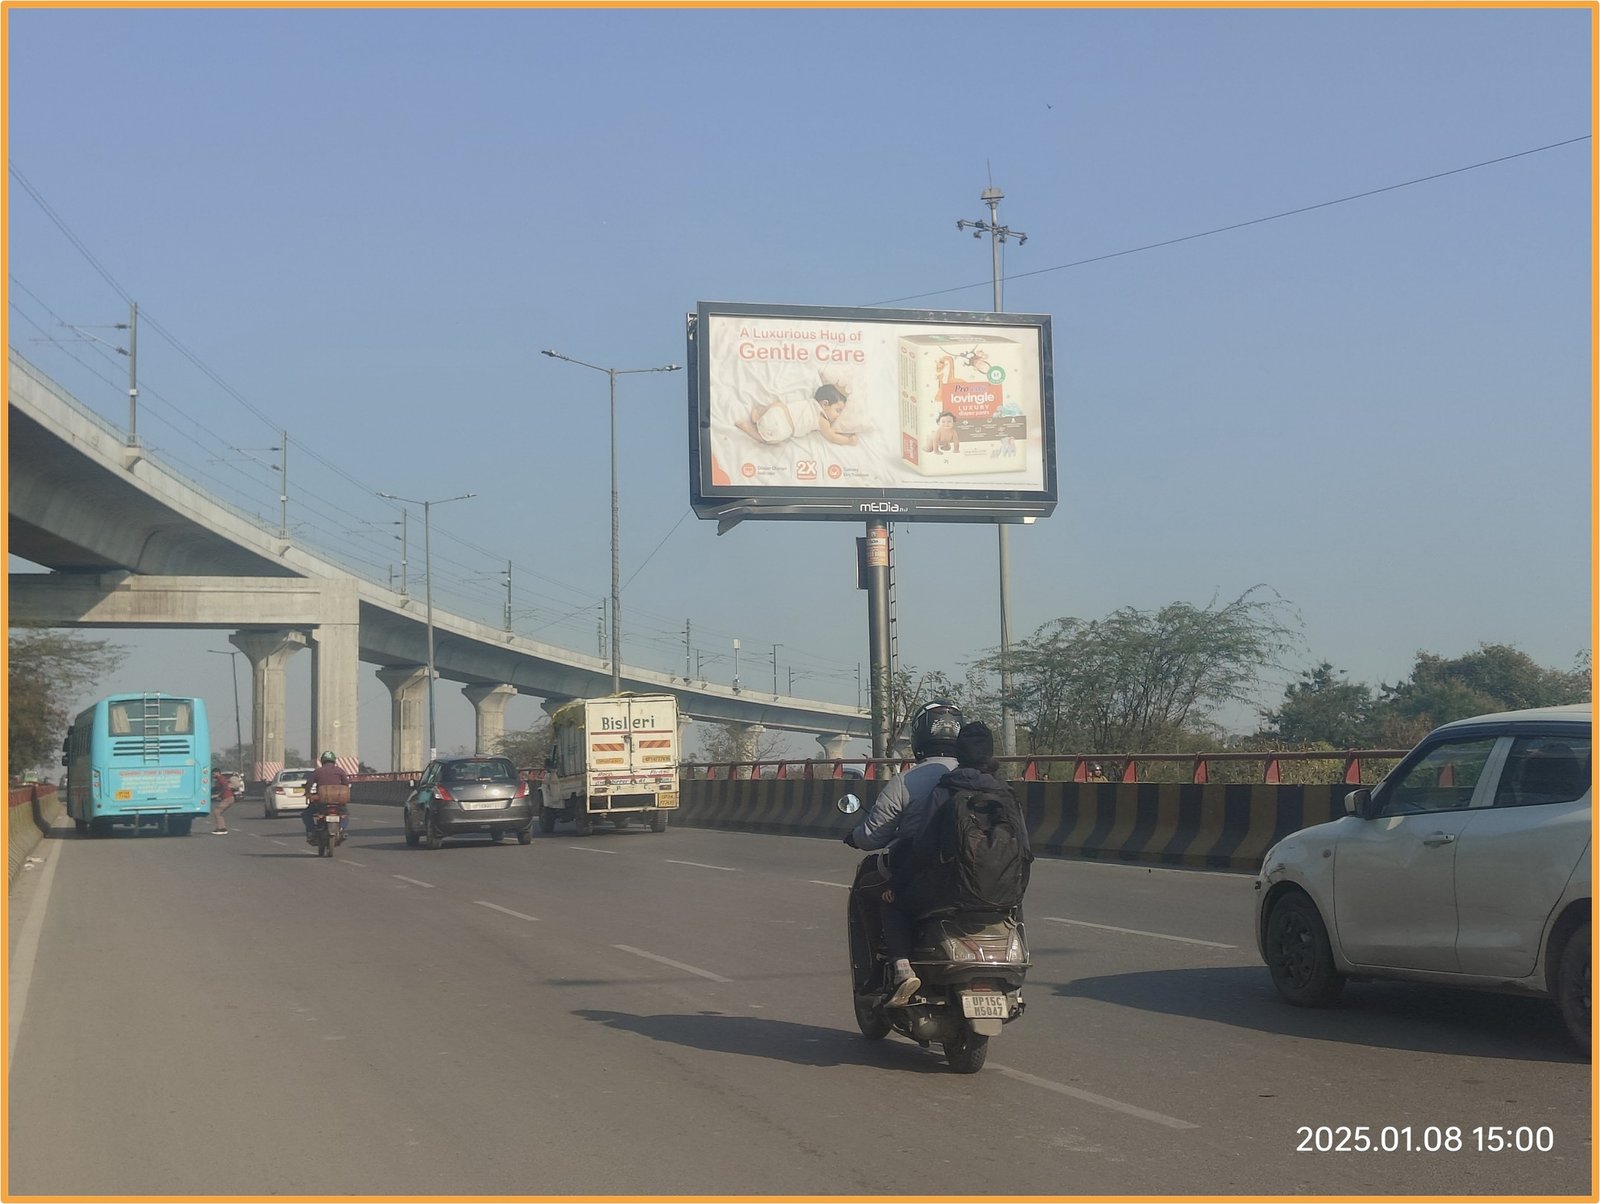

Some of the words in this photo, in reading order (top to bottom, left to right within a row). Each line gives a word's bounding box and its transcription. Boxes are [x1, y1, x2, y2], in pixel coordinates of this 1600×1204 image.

[739, 327, 750, 338] A
[753, 327, 817, 340] Luxurious
[820, 329, 846, 343] Hug
[849, 330, 863, 341] of
[738, 342, 809, 361] Gentle
[815, 344, 865, 362] Care
[950, 391, 995, 405] lovingle
[797, 460, 817, 475] 2X
[601, 715, 656, 731] Bisleri
[972, 997, 1002, 1006] UP15C
